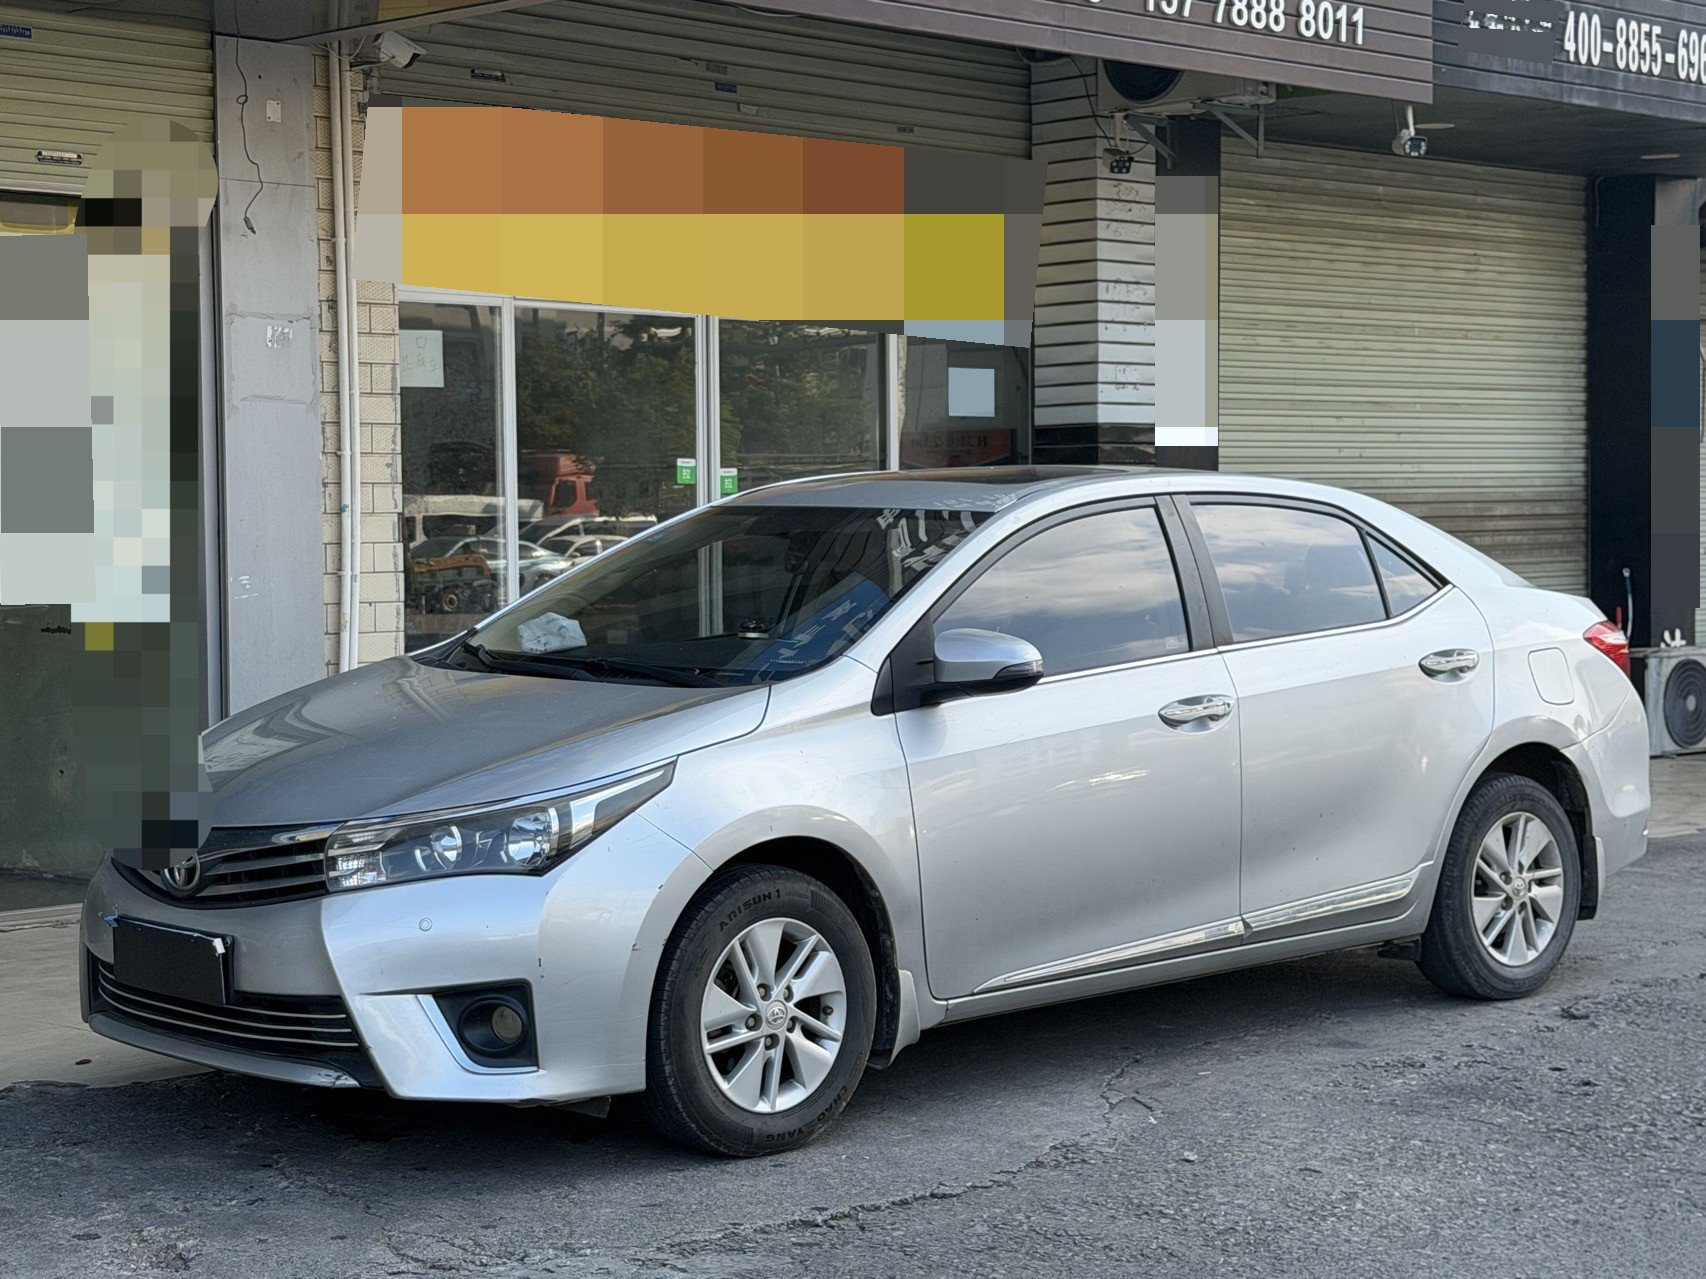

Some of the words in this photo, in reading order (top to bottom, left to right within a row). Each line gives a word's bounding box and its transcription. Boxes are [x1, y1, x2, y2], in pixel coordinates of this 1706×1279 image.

[1214, 0, 1286, 33] 7888
[1298, 0, 1365, 45] 8011
[682, 468, 692, 480] 拉
[724, 478, 734, 489] 拉
[718, 891, 773, 933] ARISUN
[765, 1126, 805, 1143] YANG
